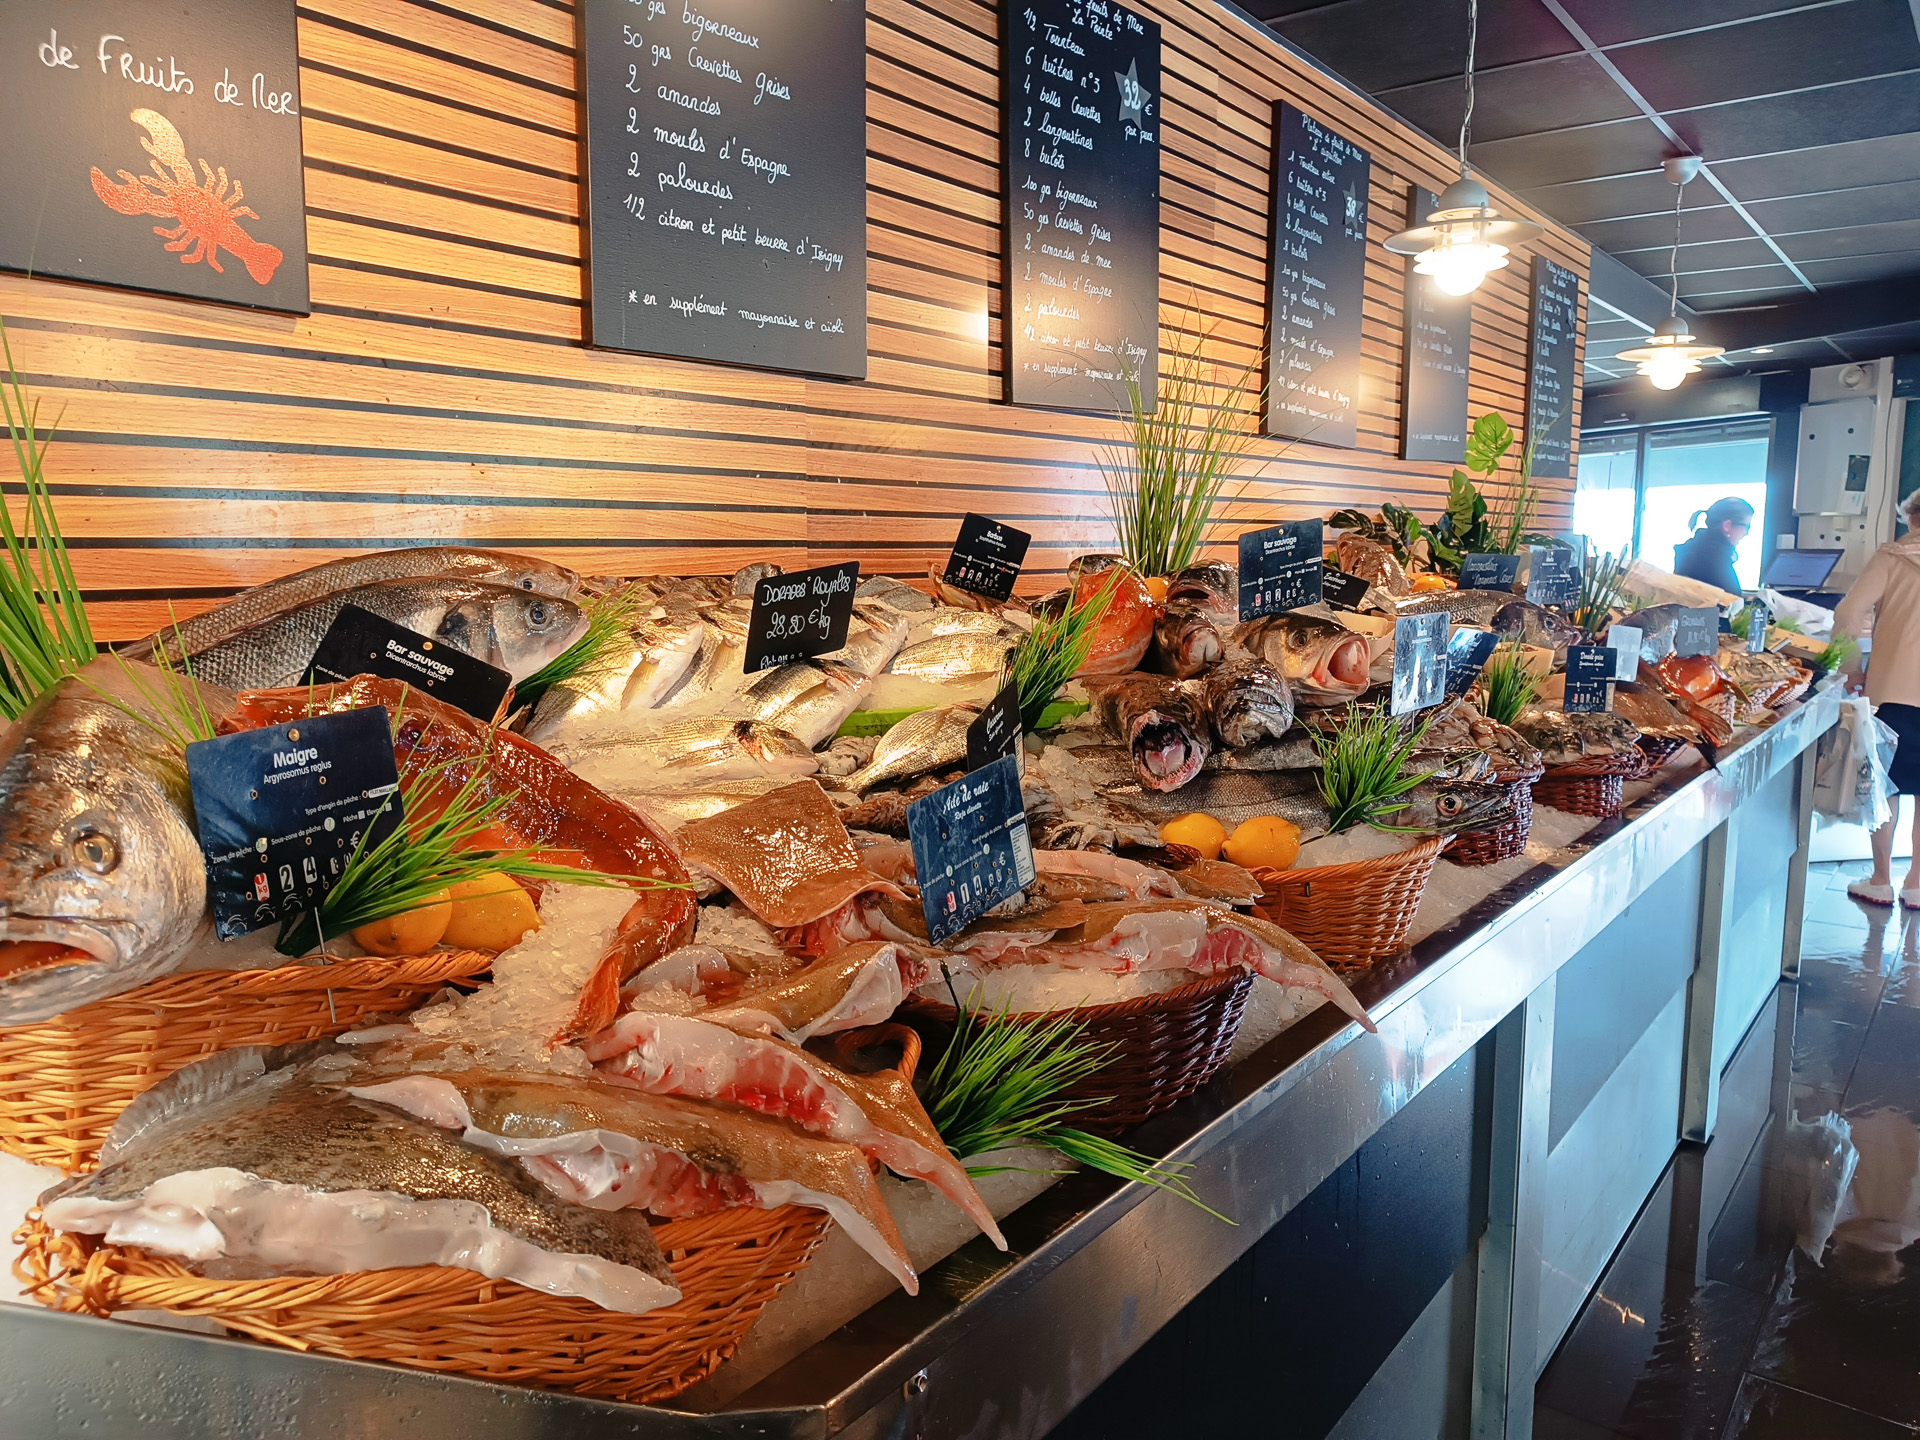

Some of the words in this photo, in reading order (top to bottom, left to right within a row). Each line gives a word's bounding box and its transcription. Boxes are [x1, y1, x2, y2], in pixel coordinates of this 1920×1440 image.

[682, 0, 760, 49] bigorneaux
[1113, 9, 1122, 25] de
[1126, 14, 1144, 36] Mer
[623, 25, 643, 48] 50
[651, 45, 672, 66] grs
[688, 47, 743, 84] Crevettes
[1044, 23, 1086, 57] Tourteau
[38, 28, 80, 69] de
[214, 67, 244, 106] de
[1025, 46, 1035, 65] 6
[1042, 54, 1074, 81] huîtres
[625, 64, 641, 93] 2
[657, 83, 721, 115] amandes
[1040, 86, 1061, 108] belles
[1071, 96, 1101, 124] Crevettes
[1123, 78, 1142, 111] 32
[626, 107, 640, 134] 2
[653, 127, 705, 153] moules
[1023, 107, 1032, 127] 2
[1040, 145, 1066, 169] bulots
[627, 152, 641, 177] 2
[658, 162, 733, 200] palourdes
[1055, 181, 1099, 211] bigorneaux
[658, 208, 694, 231] citron
[701, 218, 715, 235] et
[721, 223, 747, 245] petit
[755, 228, 790, 253] beurre
[1024, 202, 1034, 220] 50
[1055, 212, 1084, 235] Crevettes
[1041, 243, 1075, 261] amandes
[1081, 250, 1090, 263] de
[1040, 270, 1067, 289] moules
[643, 293, 657, 306] en
[669, 294, 728, 318] supplément
[738, 309, 800, 329] mayonnaise
[805, 318, 815, 330] et
[821, 321, 845, 334] aïoli
[1038, 297, 1080, 320] palourdes
[1273, 536, 1297, 547] sauvage
[385, 650, 427, 673] Dicentrarchus
[426, 669, 448, 683] labrax
[386, 638, 408, 655] Bar
[407, 648, 455, 676] sauvage
[273, 746, 318, 769] Maigre
[263, 767, 310, 784] Argyrosomus
[962, 788, 972, 803] de
[973, 780, 990, 799] raie
[305, 808, 317, 816] Type
[317, 802, 336, 812] d'engin
[227, 851, 236, 859] de
[258, 886, 268, 895] kg
